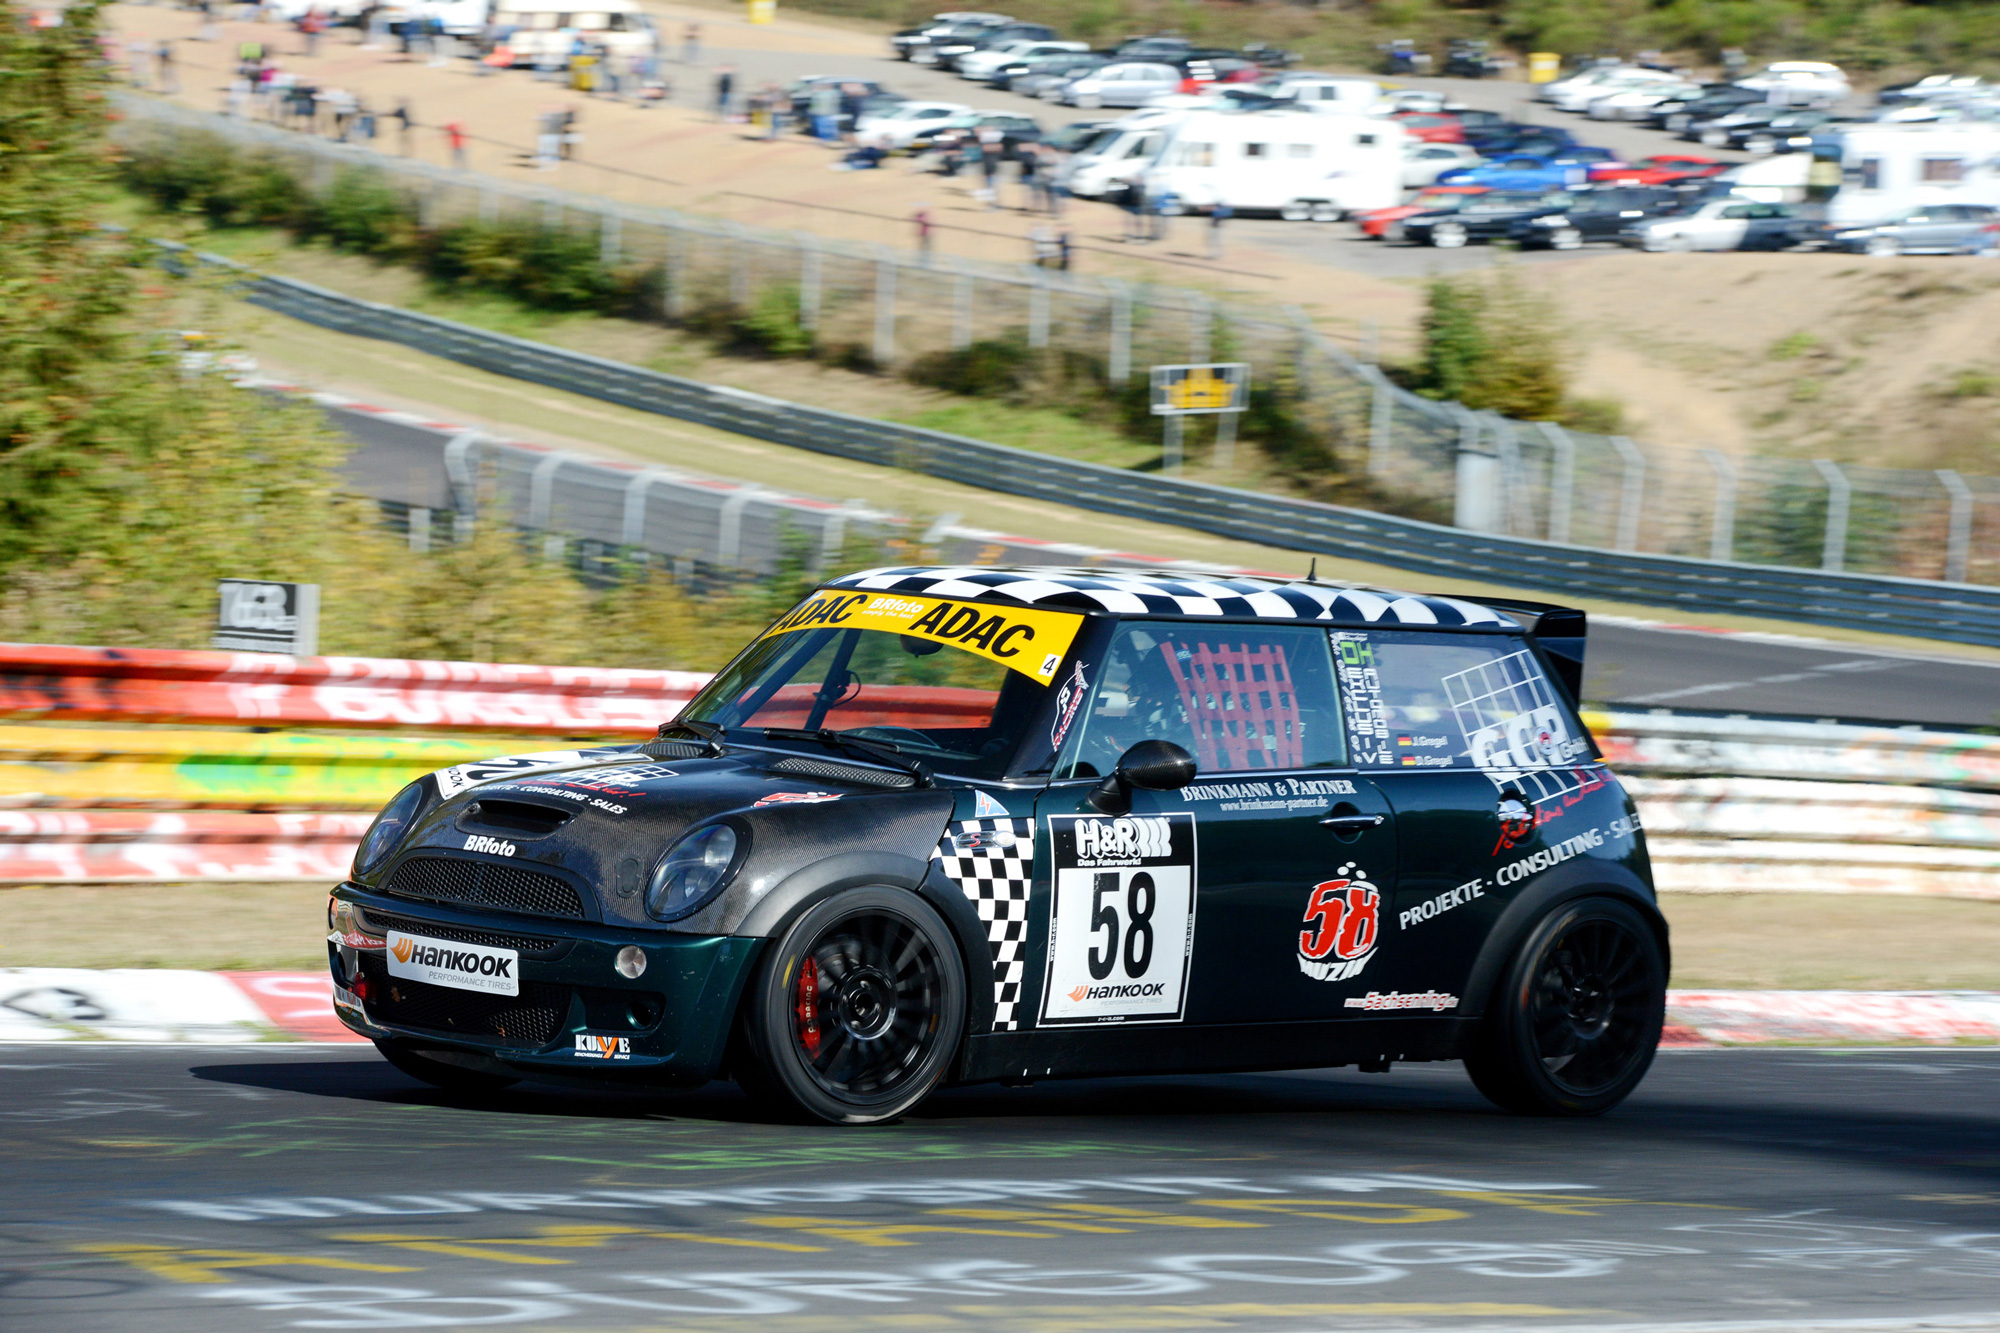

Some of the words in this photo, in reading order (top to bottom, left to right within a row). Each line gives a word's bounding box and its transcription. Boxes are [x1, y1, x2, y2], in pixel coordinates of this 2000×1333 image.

[778, 594, 868, 631] ADAC
[868, 598, 924, 613] BRfoto
[908, 602, 1035, 657] ADAC
[1043, 657, 1057, 674] 4
[1179, 782, 1274, 802] BRINKMANN
[1276, 782, 1288, 796] &
[1285, 778, 1358, 796] PARTNER
[590, 799, 628, 814] SALES
[463, 834, 516, 857] BRfoto
[1399, 878, 1485, 930] PROJEKTE
[1496, 828, 1604, 886] CONSULTING
[1088, 871, 1156, 980] 58
[1299, 879, 1381, 960] 58
[428, 970, 485, 987] PERFORMANCE
[487, 979, 512, 991] TIRES
